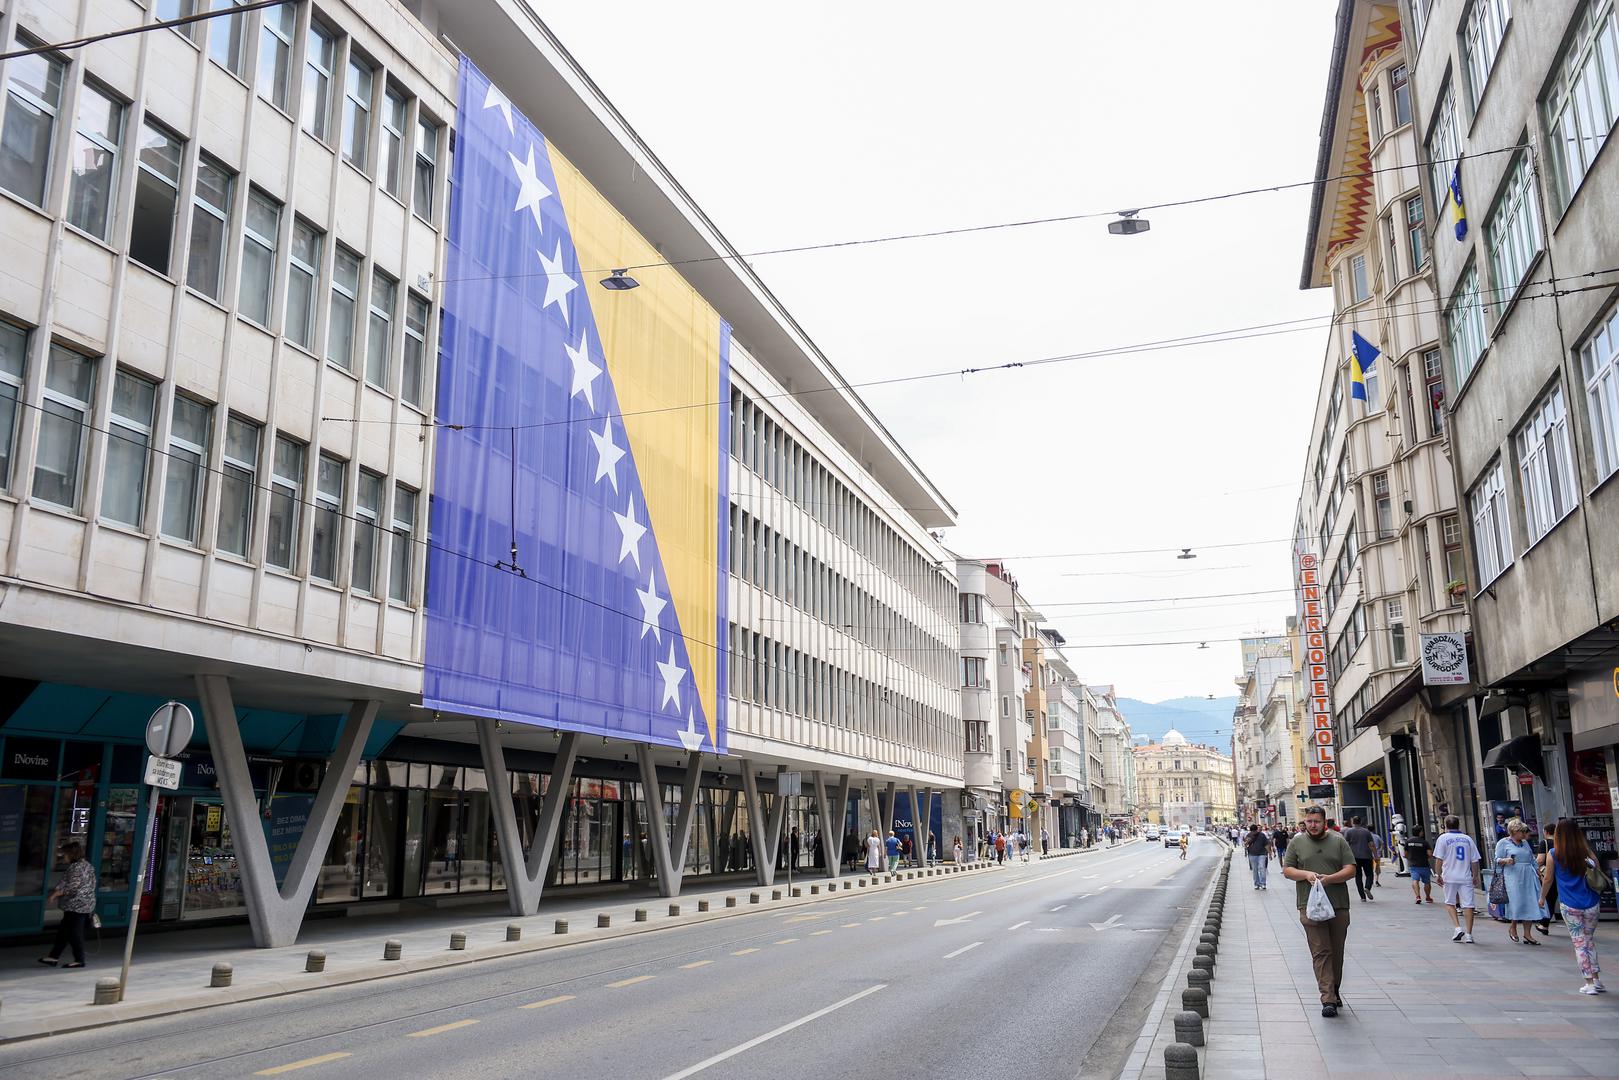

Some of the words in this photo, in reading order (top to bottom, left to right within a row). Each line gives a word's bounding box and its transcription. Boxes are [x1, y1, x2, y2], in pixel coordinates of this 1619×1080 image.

[1304, 569, 1332, 761] ENERGOPETROL
[14, 753, 49, 766] iNovine
[197, 763, 216, 775] iNov
[1456, 845, 1465, 861] 9
